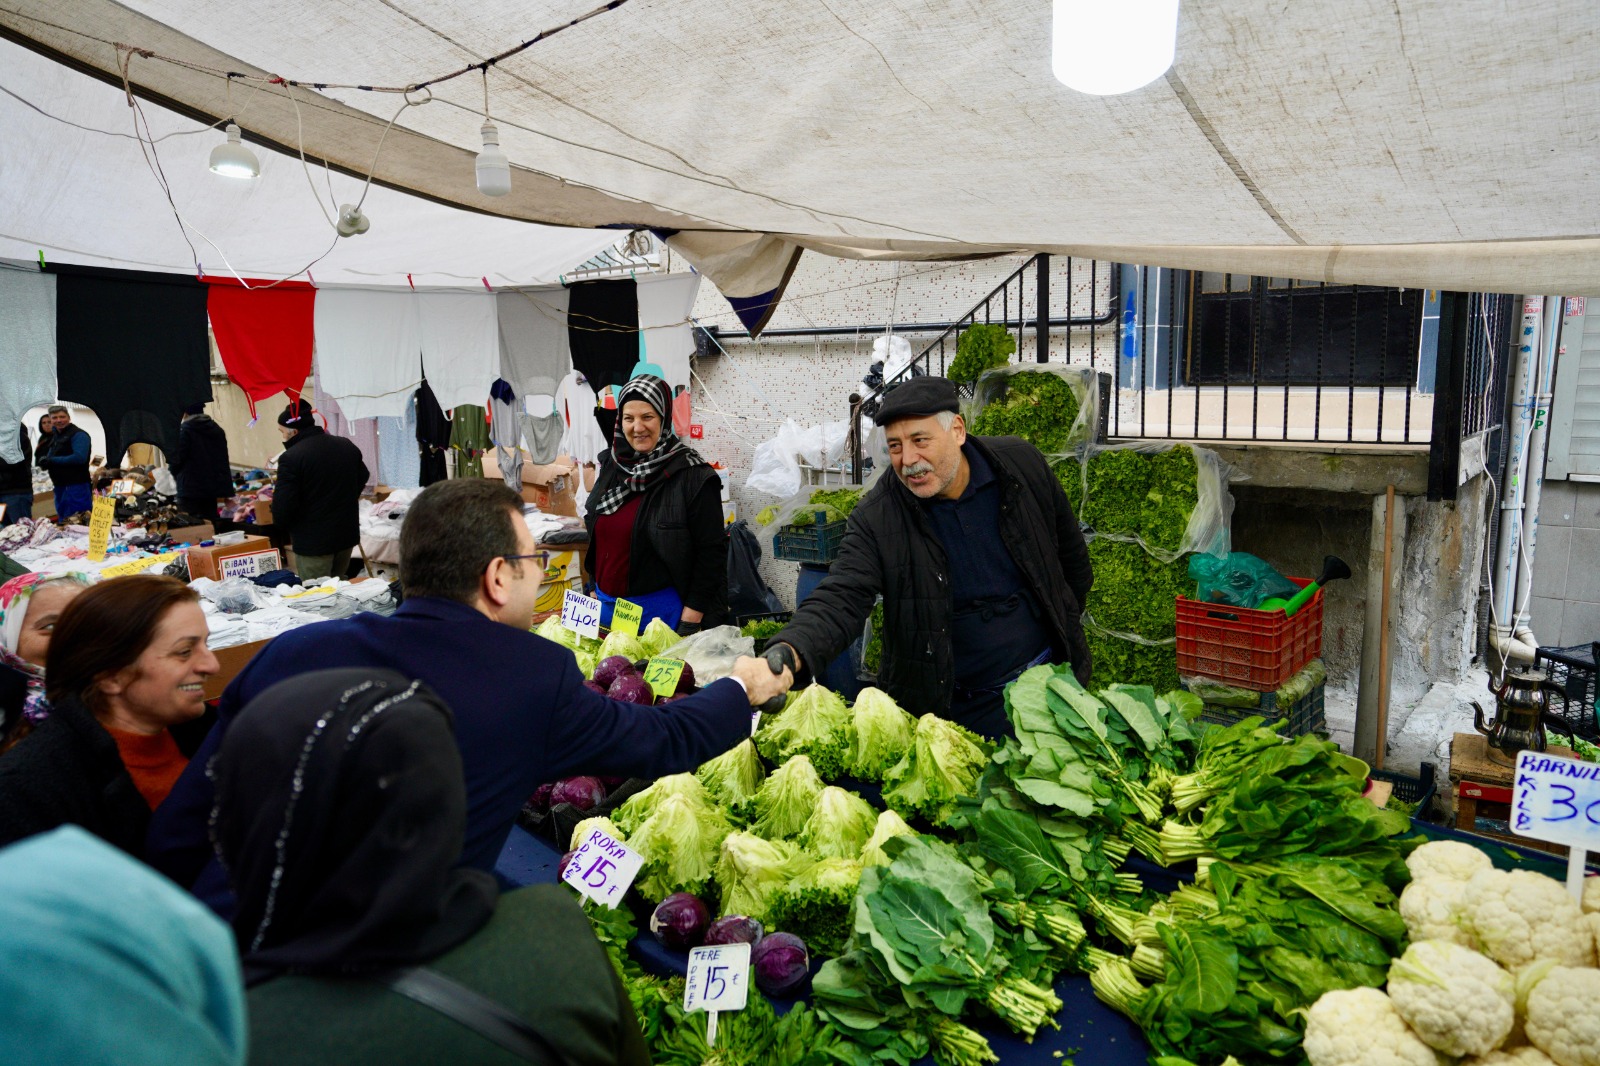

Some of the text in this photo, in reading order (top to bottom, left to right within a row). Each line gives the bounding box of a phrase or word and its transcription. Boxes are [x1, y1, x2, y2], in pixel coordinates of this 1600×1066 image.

[226, 566, 255, 578] HAVALE
[589, 830, 626, 859] ROKA
[581, 855, 617, 888] 15
[694, 950, 722, 961] TERE
[687, 965, 698, 1008] DEMET
[703, 966, 729, 1000] 15
